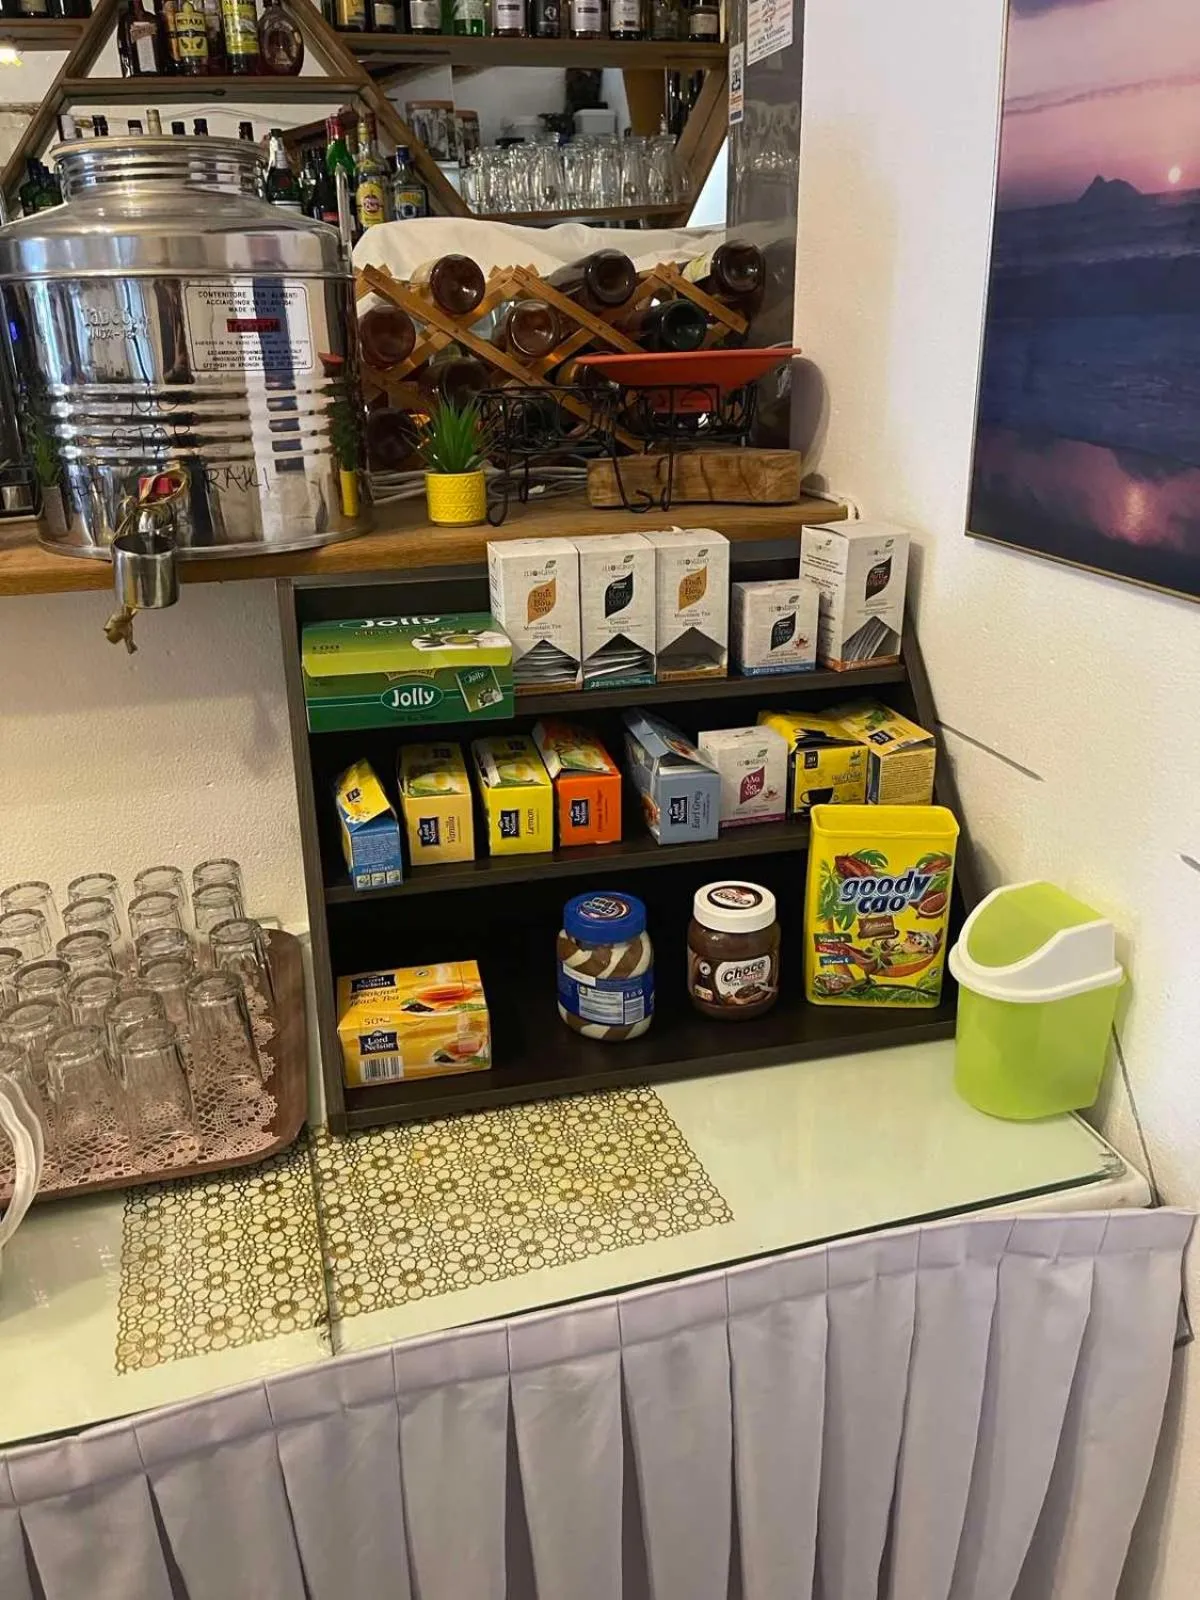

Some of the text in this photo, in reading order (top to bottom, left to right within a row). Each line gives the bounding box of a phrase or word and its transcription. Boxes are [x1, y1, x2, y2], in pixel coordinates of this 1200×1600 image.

[203, 465, 270, 494] RAKI
[360, 616, 441, 628] Jolly
[467, 671, 486, 684] Jolly
[391, 687, 435, 708] Jolly
[692, 810, 700, 829] Earl
[840, 869, 934, 902] goody
[715, 892, 752, 905] Choco
[858, 895, 906, 913] cao
[724, 960, 766, 983] Choco
[364, 1042, 395, 1052] Nelson
[367, 1036, 389, 1046] Lord
